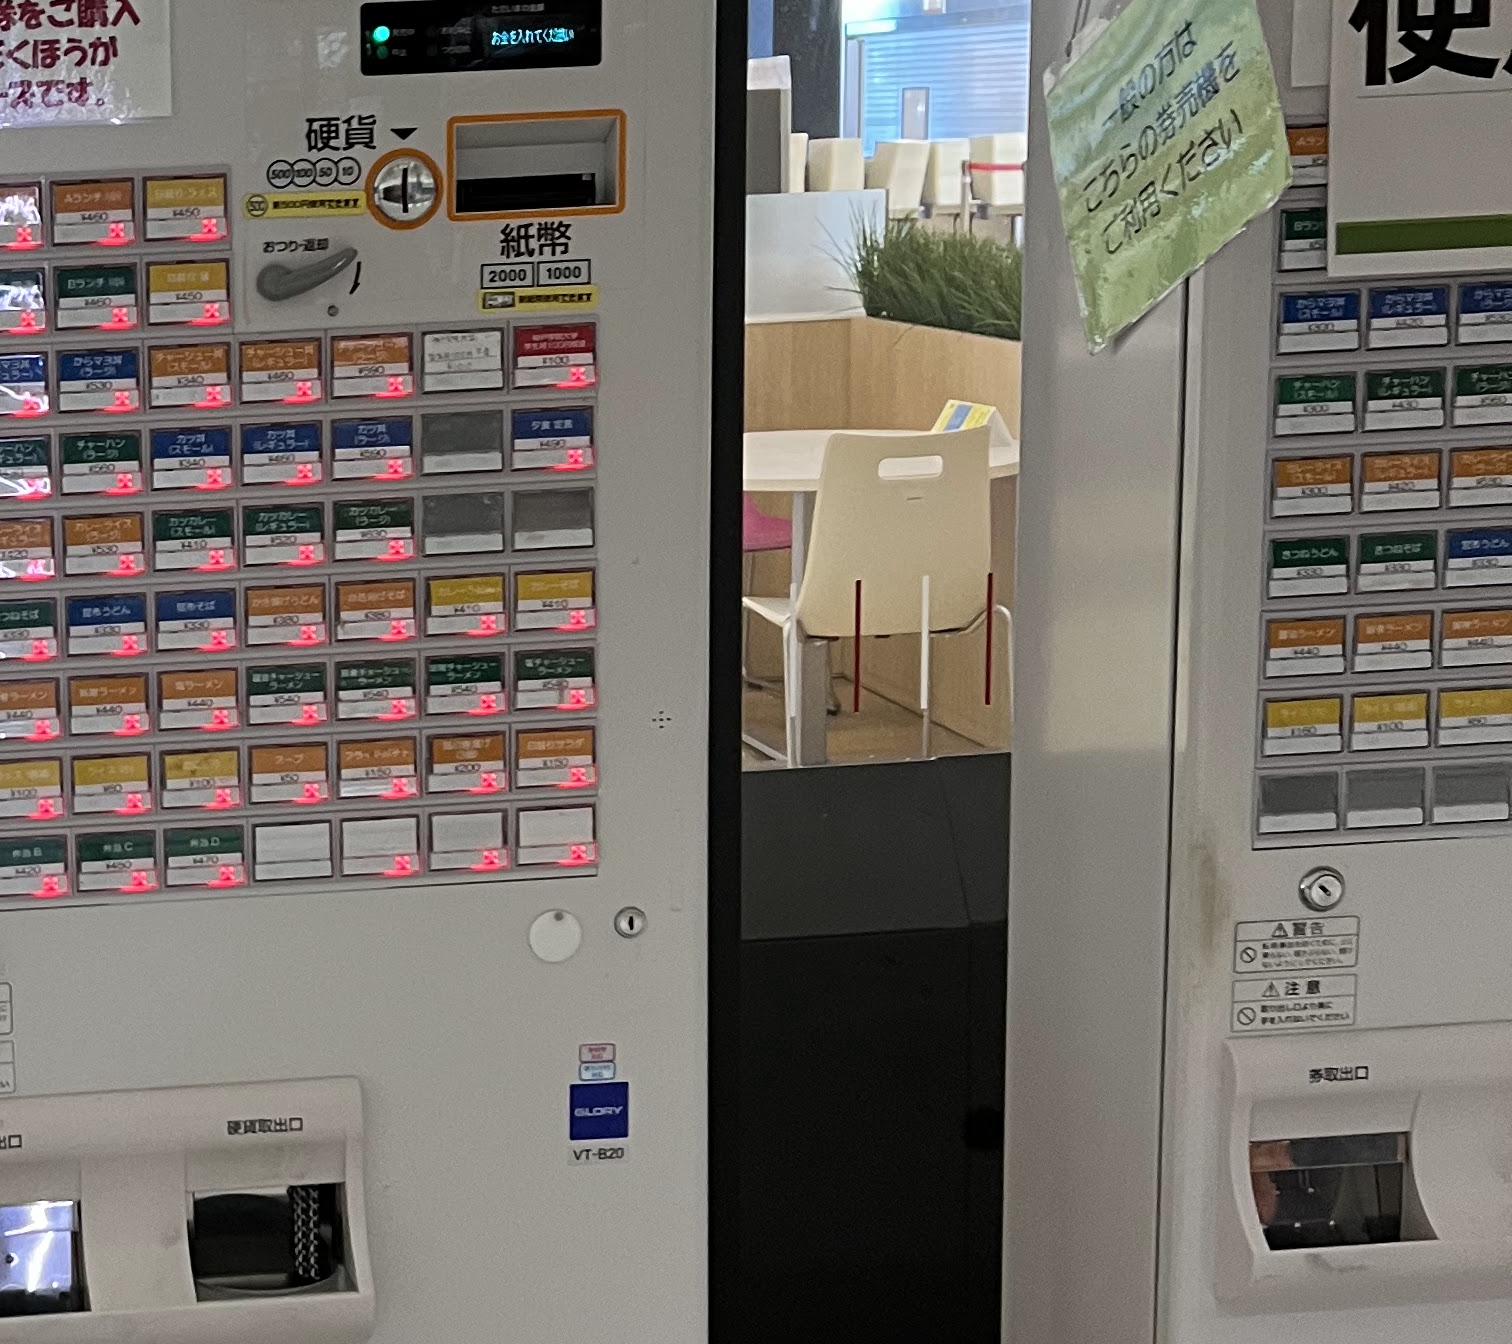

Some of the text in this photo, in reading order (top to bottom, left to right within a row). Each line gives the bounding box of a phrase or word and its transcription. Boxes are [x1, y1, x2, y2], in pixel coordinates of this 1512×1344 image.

[305, 115, 376, 152] 硬貨
[270, 168, 291, 179] 500
[499, 222, 572, 258] 紙幣
[489, 267, 581, 283] 2000 1000
[1309, 1065, 1370, 1084] 券取出口
[573, 1106, 624, 1118] GLORY
[572, 1146, 625, 1161] VT-B20
